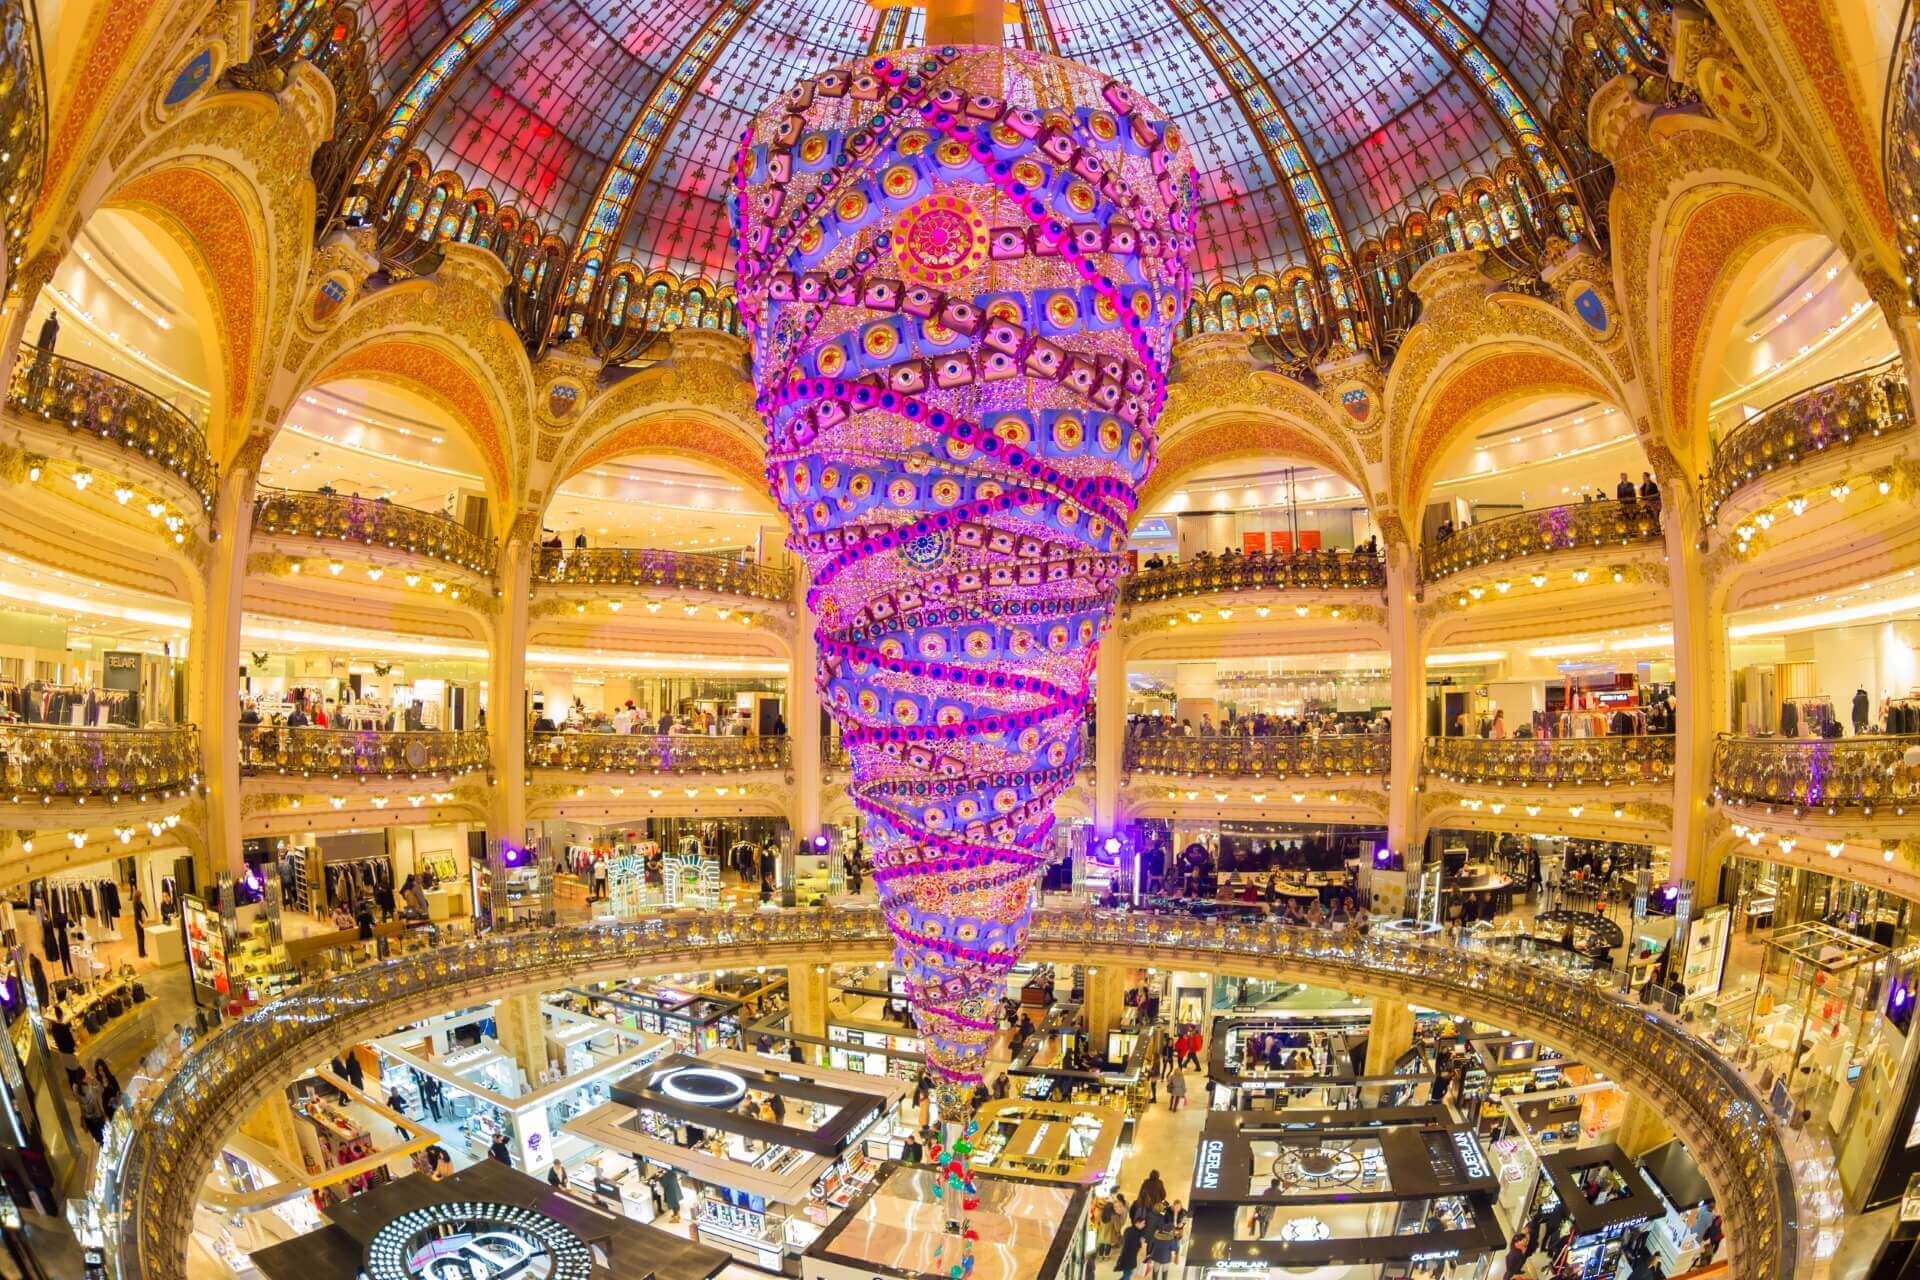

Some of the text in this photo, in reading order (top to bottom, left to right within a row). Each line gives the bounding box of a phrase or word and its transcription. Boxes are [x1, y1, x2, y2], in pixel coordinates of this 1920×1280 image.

[1203, 1140, 1224, 1189] GUERLAIN
[1453, 1131, 1484, 1178] GUERLAIN
[1602, 1216, 1648, 1232] GIVENCHY
